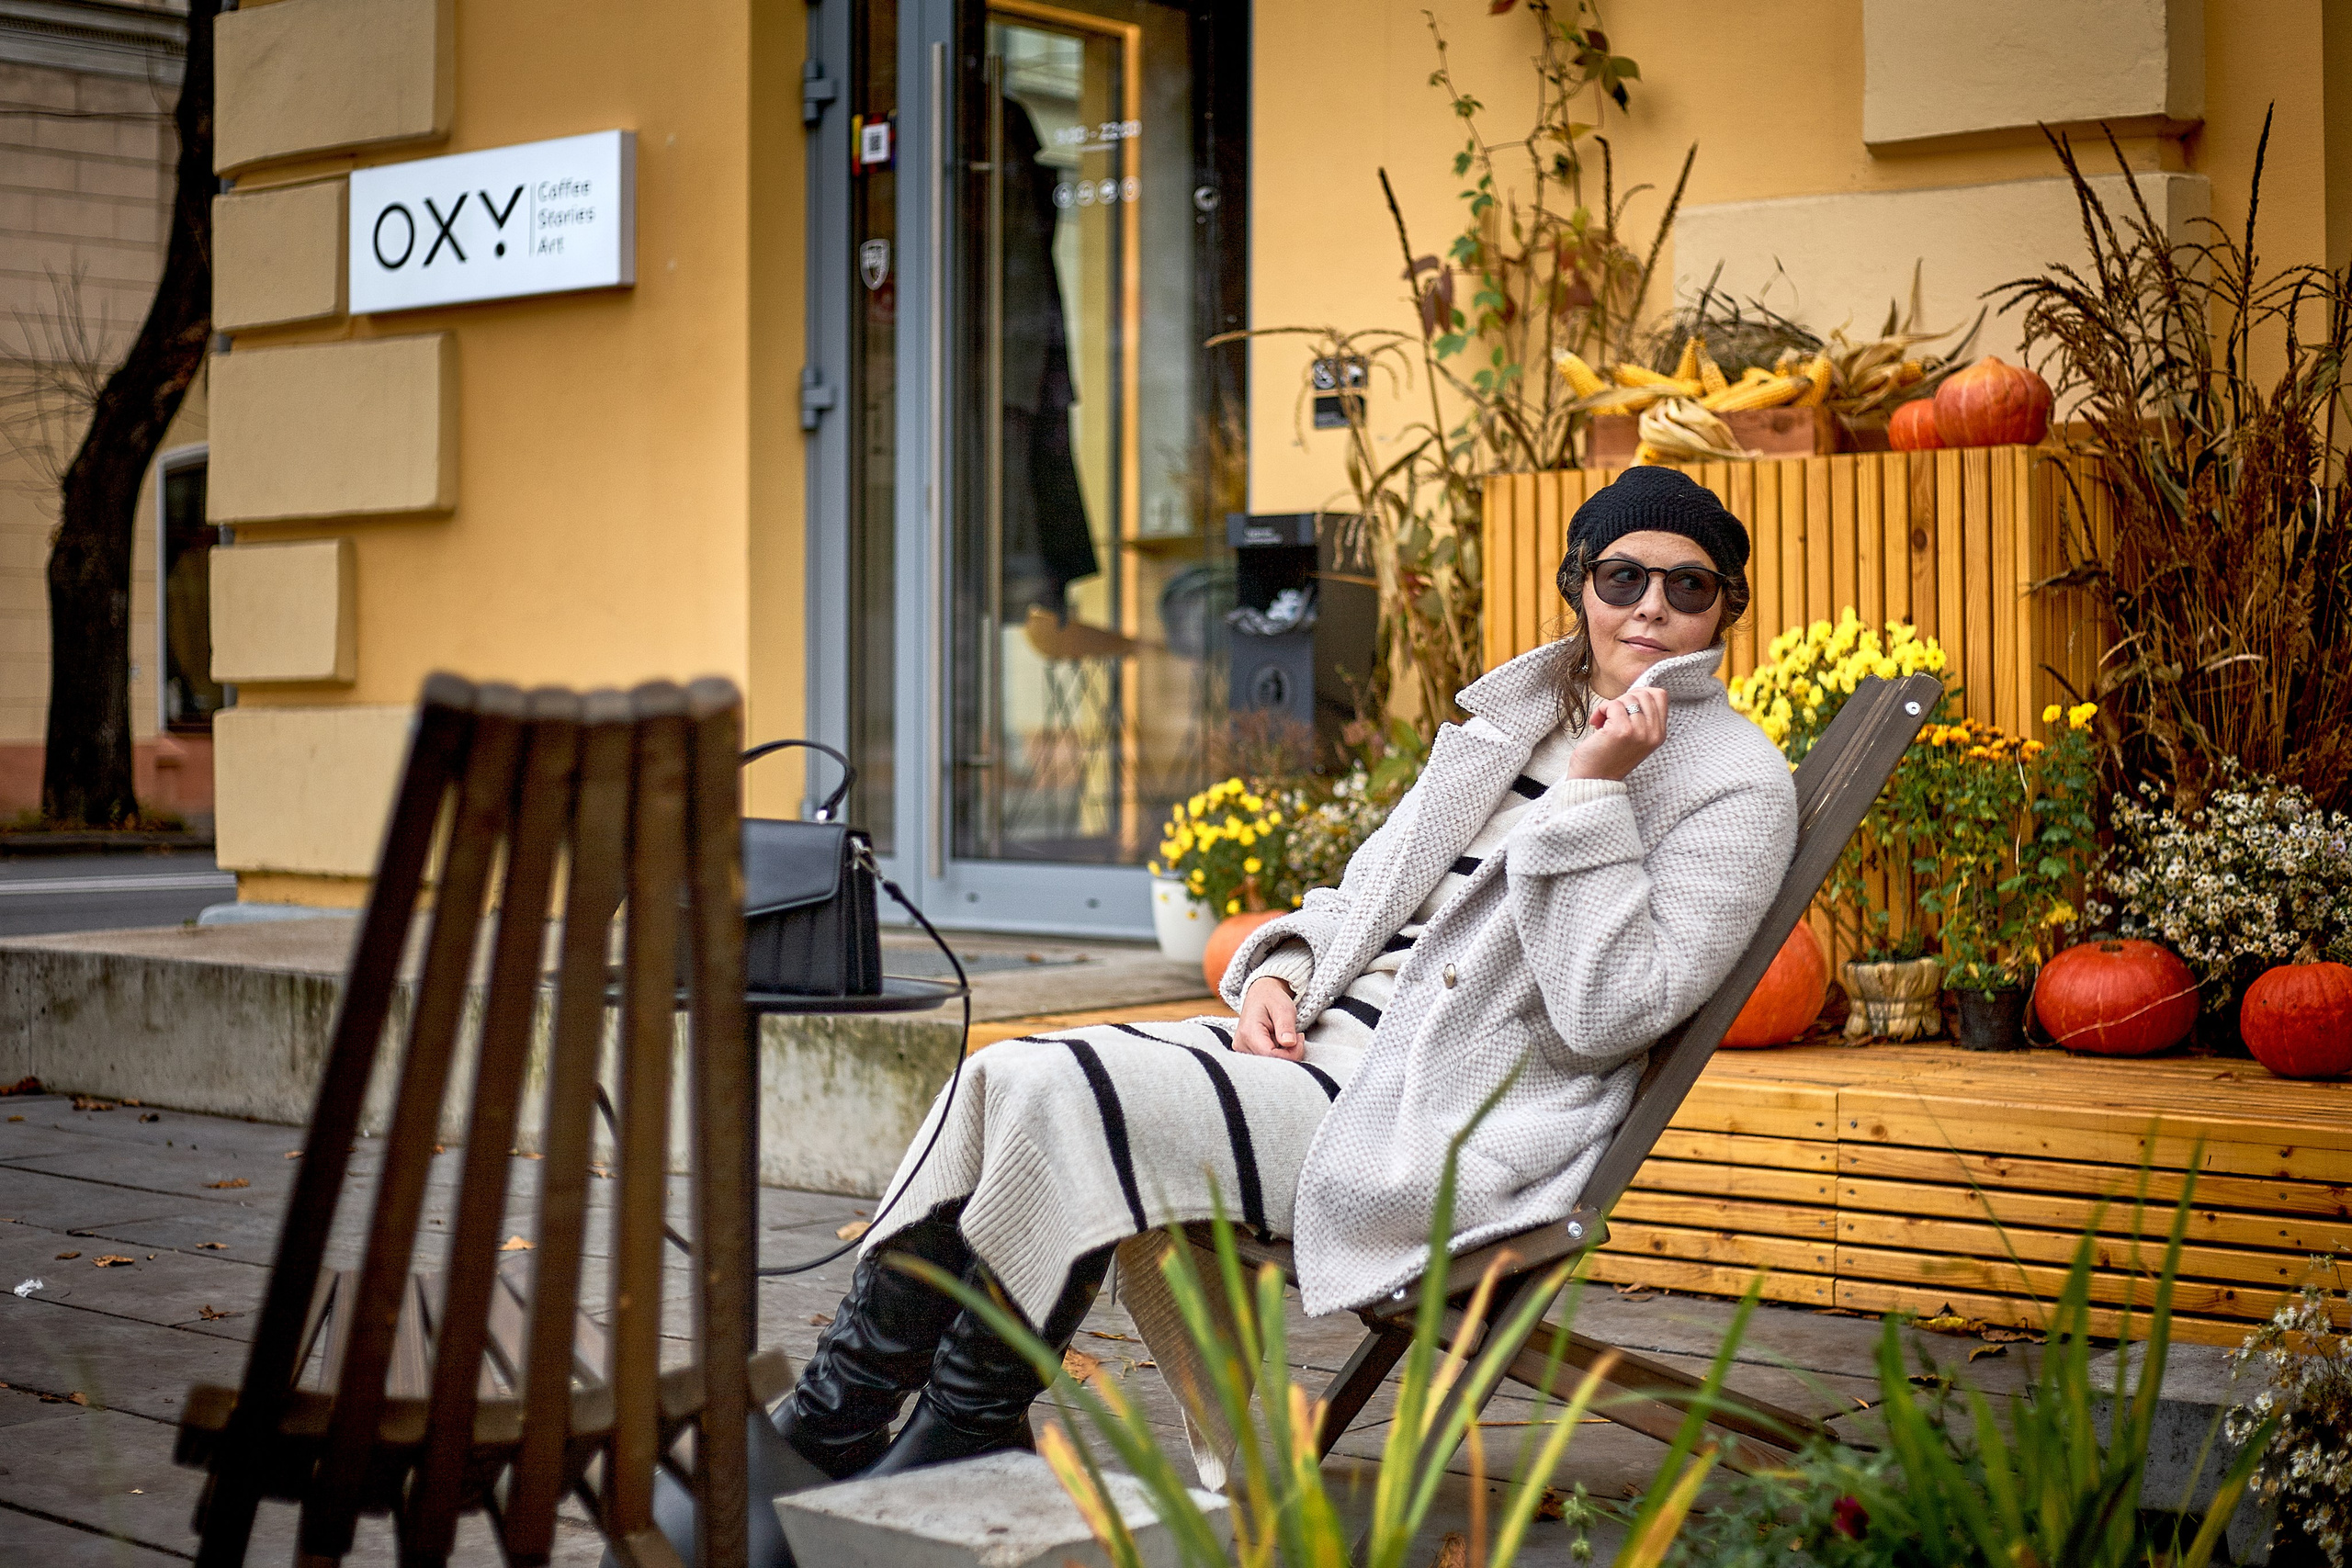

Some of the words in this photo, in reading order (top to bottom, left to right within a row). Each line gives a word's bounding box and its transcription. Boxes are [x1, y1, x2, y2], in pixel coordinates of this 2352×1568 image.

[537, 177, 593, 202] Coffee
[537, 204, 596, 230] Stories
[537, 234, 564, 256] Art
